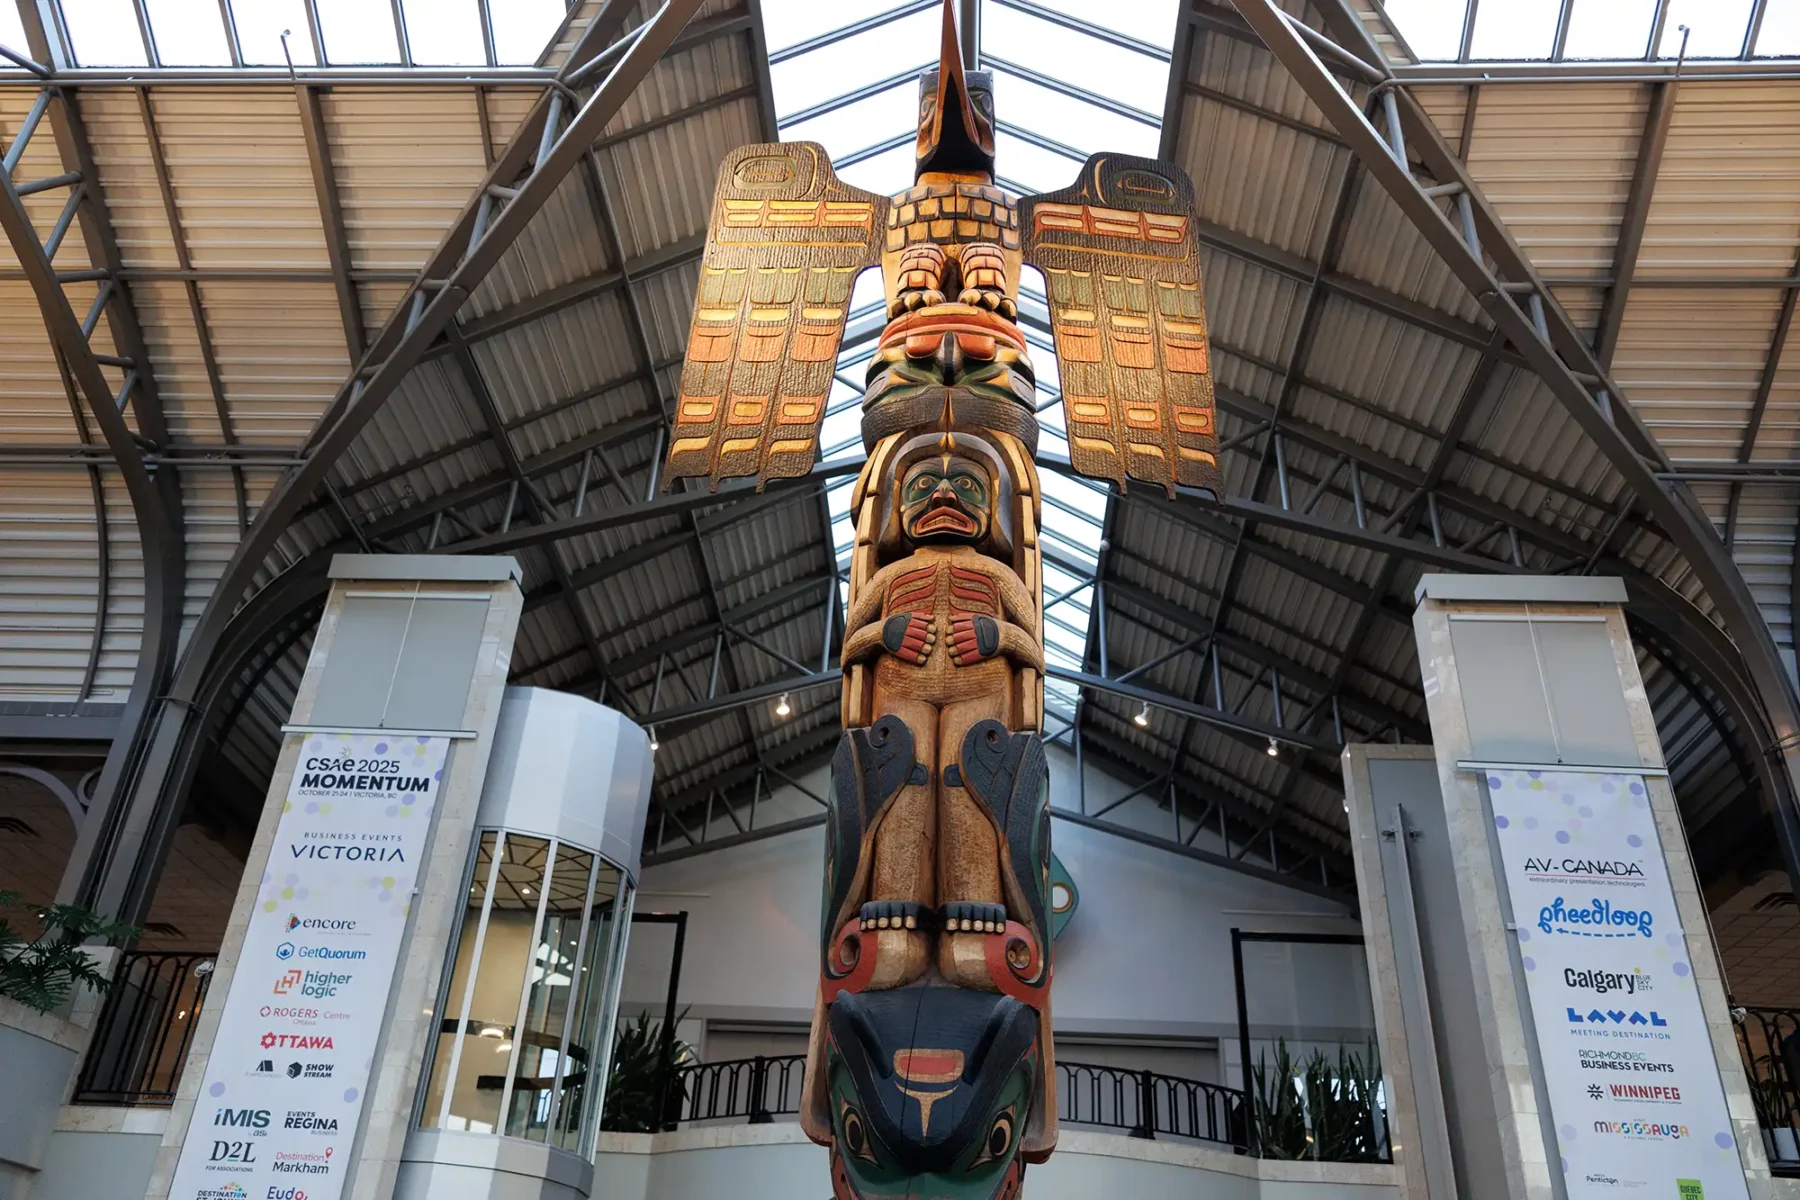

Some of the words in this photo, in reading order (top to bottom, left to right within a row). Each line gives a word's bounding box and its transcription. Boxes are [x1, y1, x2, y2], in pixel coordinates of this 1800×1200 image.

[357, 759, 400, 774] 2025
[300, 773, 430, 792] MOMENTUM
[353, 791, 386, 799] VICTORIA,
[304, 832, 357, 840] BUSINESS
[291, 844, 405, 862] VICTORIA
[1529, 877, 1568, 885] extraordinary
[1569, 878, 1605, 886] presentation
[1537, 896, 1653, 938] pheedloop
[302, 918, 356, 930] encore
[298, 946, 366, 960] GetQuorum
[304, 970, 353, 986] higher
[1564, 967, 1635, 995] Calgary
[301, 983, 337, 999] logic
[273, 1007, 319, 1018] ROGERS
[323, 1010, 351, 1020] Centre
[1566, 1007, 1667, 1027] LAVAL
[1570, 1029, 1609, 1037] MEETING
[1612, 1031, 1671, 1040] DESTINATION
[1580, 1060, 1631, 1071] BUSINESS
[1633, 1062, 1674, 1073] EVENTS
[1609, 1084, 1681, 1100] WINNIPEG
[214, 1108, 271, 1128] iMIS
[284, 1117, 338, 1130] REGINA
[209, 1140, 257, 1163] D2L
[276, 1152, 324, 1162] Destination
[272, 1162, 329, 1174] Markham
[1586, 1175, 1619, 1185] Penticton
[197, 1190, 247, 1198] DESTINATION
